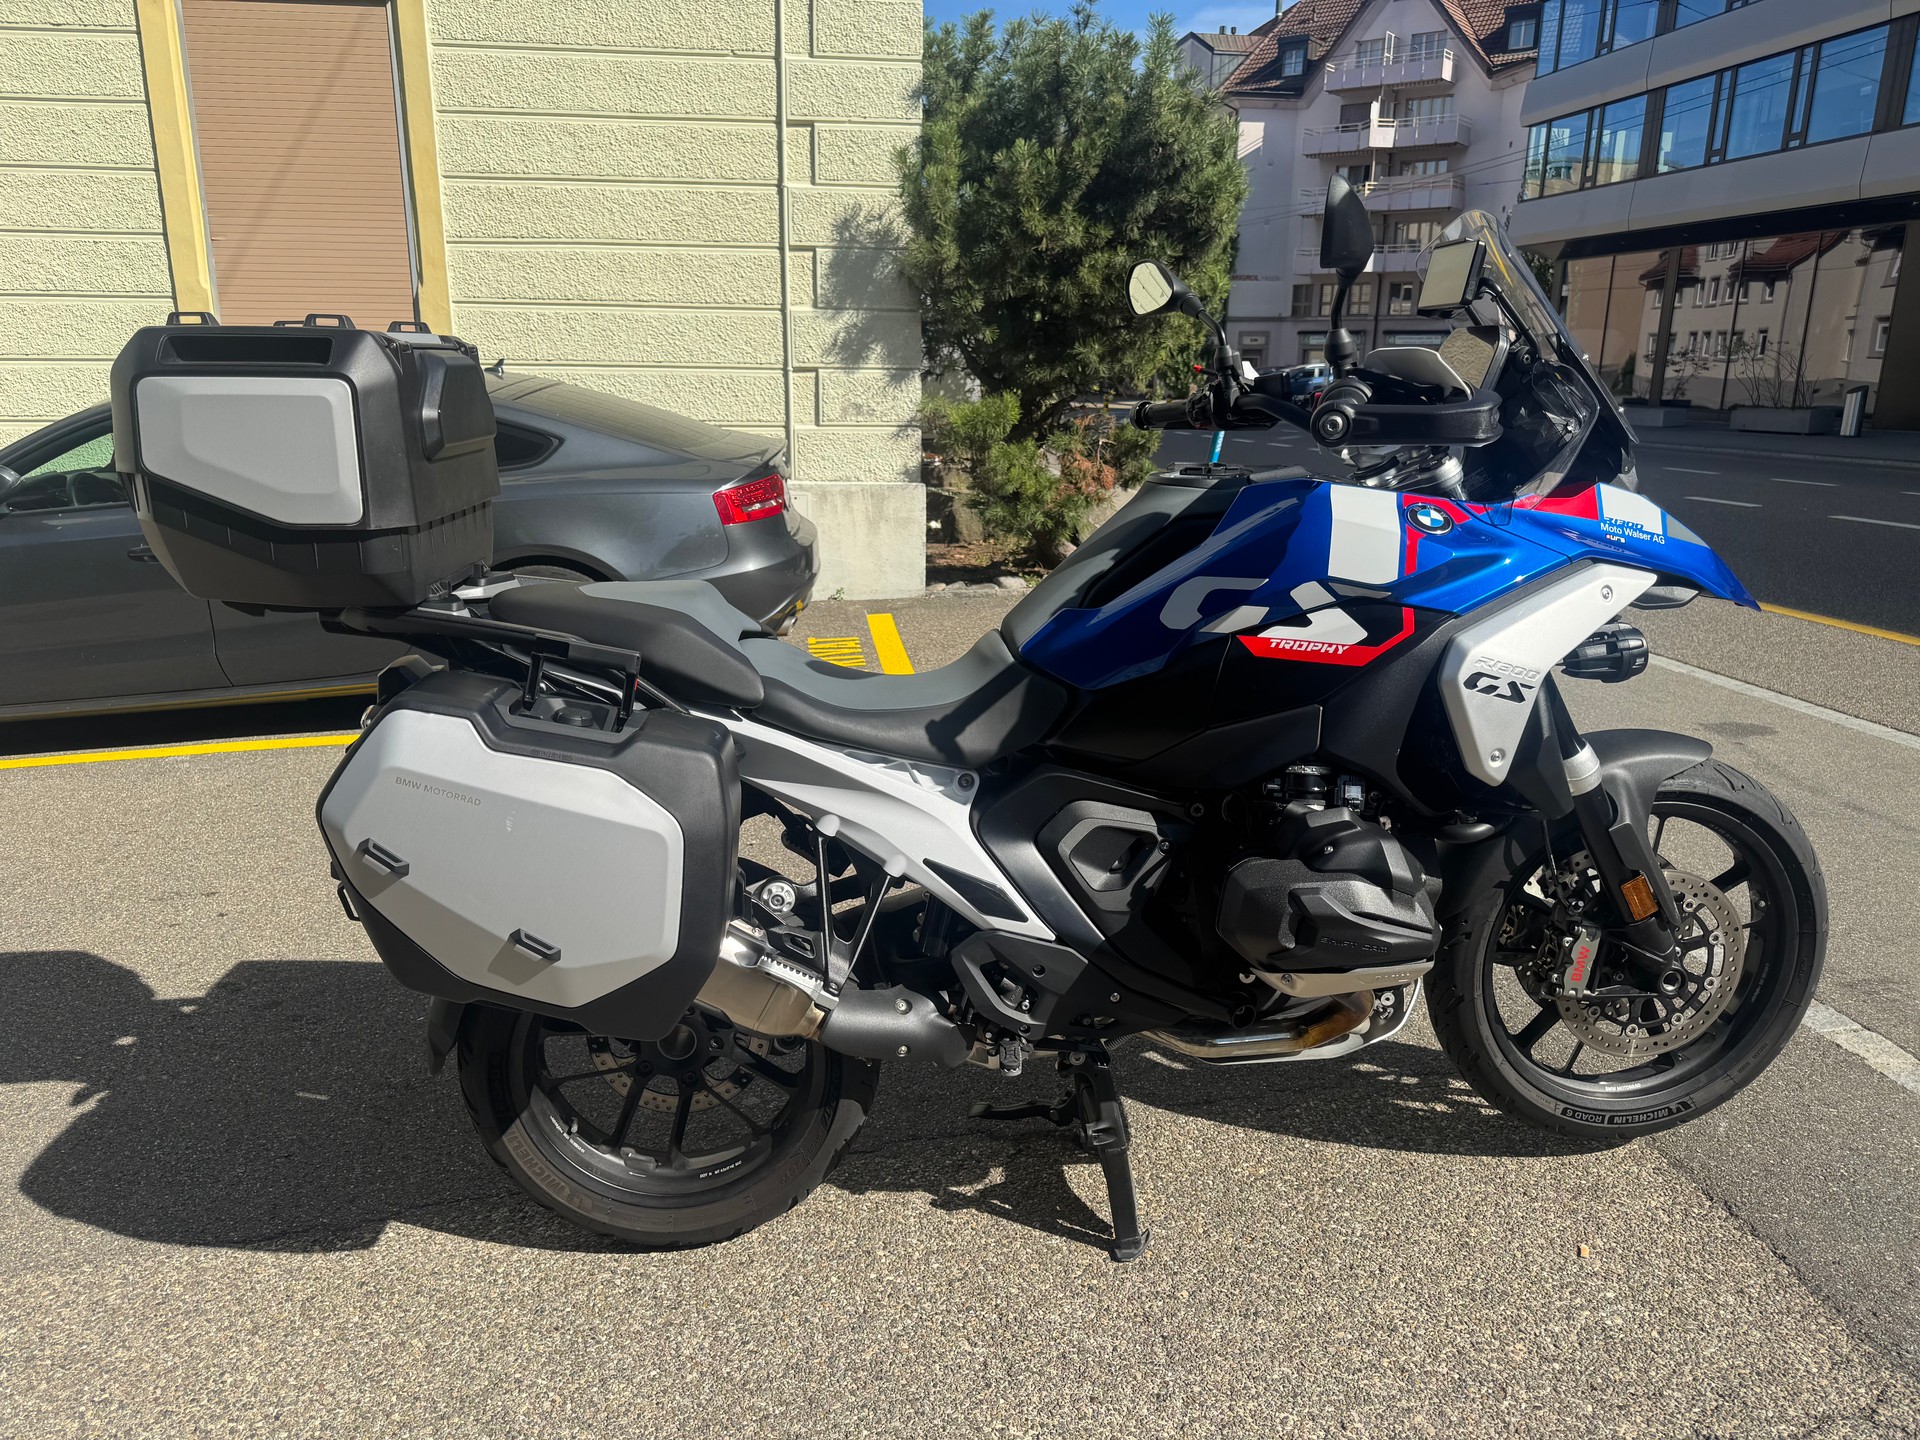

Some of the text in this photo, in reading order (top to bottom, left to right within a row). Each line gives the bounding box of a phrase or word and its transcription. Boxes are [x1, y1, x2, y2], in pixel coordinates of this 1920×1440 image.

[1600, 522, 1665, 545] Moto Walser AG
[1269, 638, 1350, 655] TROPHY
[1463, 671, 1536, 704] GS
[395, 776, 481, 806] BMW MOTORRAD
[1570, 945, 1591, 983] BMW
[1565, 1108, 1669, 1125] MICHELIN ROAD 6
